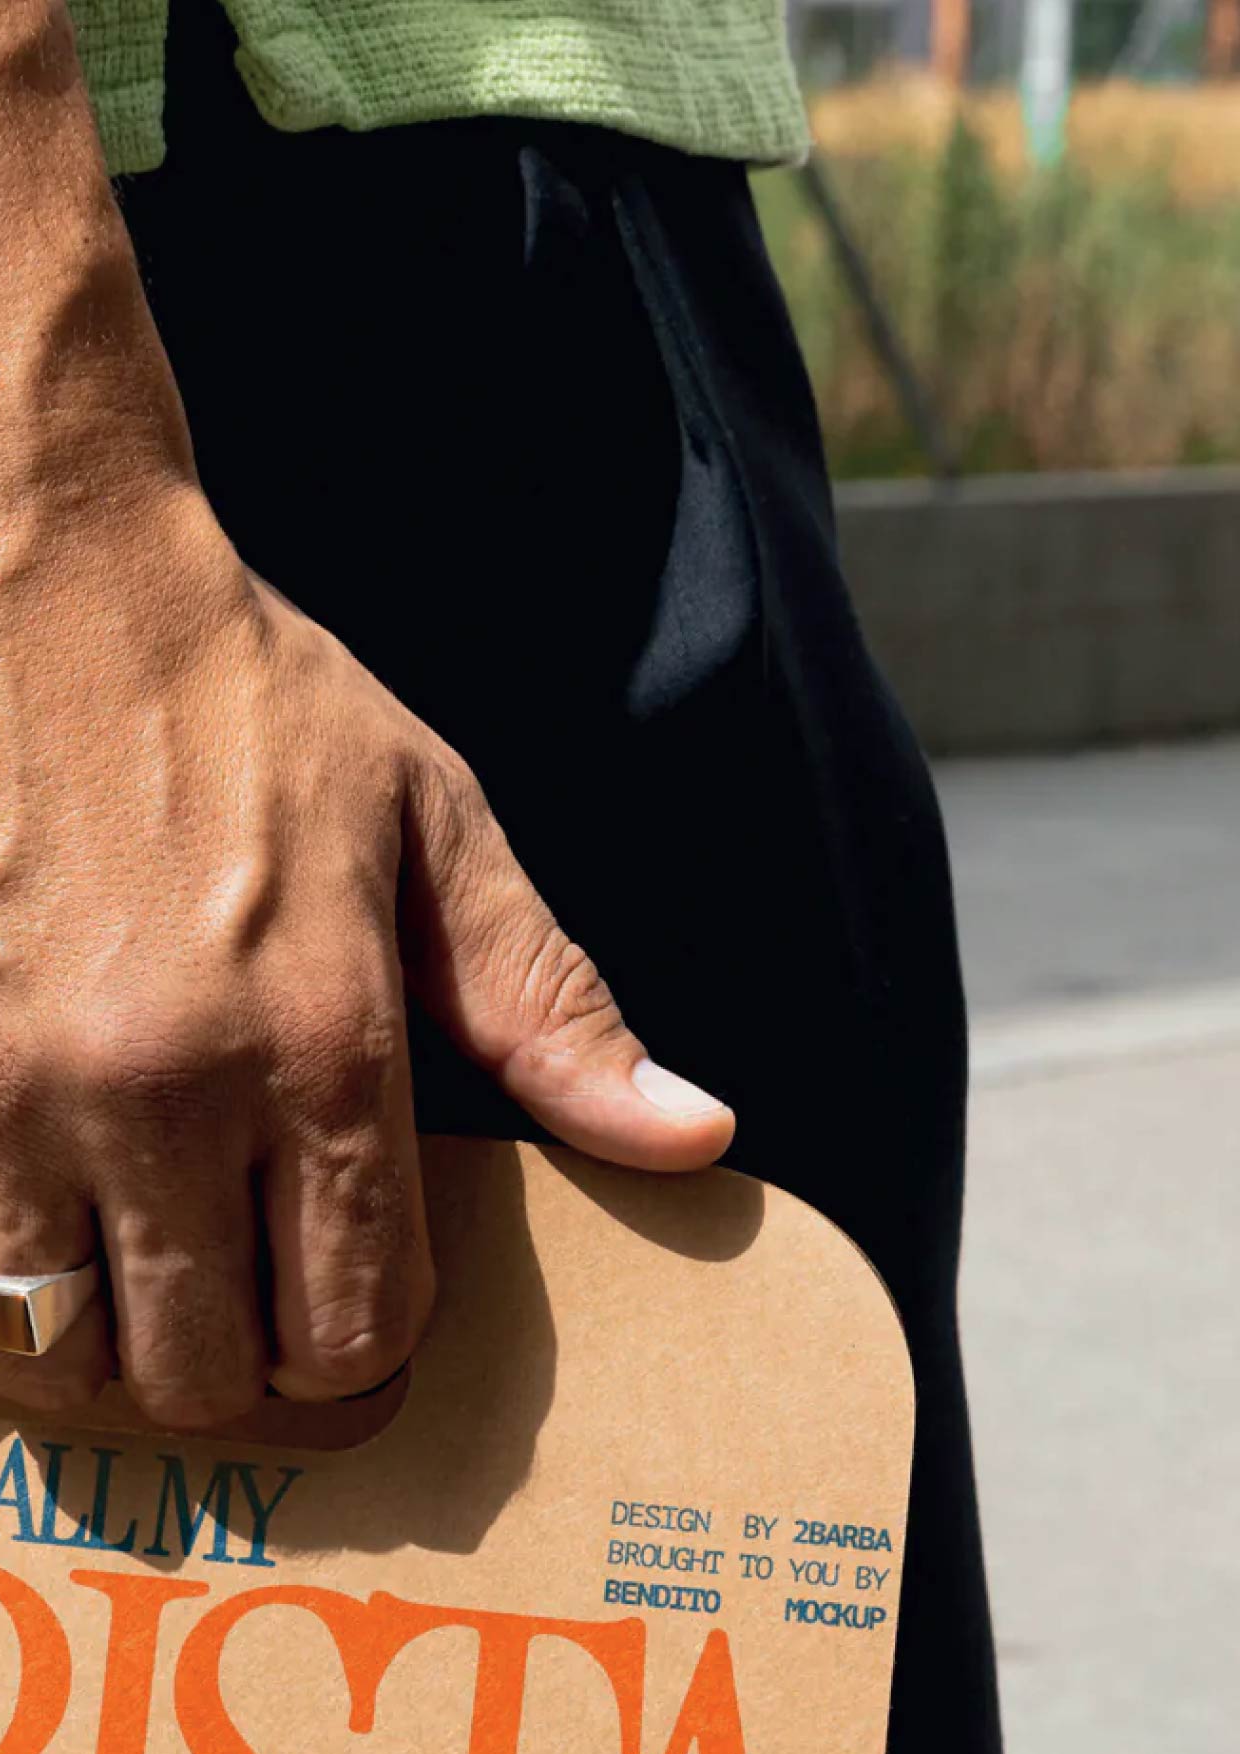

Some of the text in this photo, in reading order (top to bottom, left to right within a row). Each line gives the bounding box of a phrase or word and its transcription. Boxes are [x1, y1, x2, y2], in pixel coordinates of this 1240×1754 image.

[144, 1453, 304, 1568] MY
[611, 1500, 893, 1553] DESIGN BY 2BARBA
[607, 1539, 891, 1591] BROUGHT TO YOU BY
[603, 1578, 888, 1631] BENDITO MOCKUP
